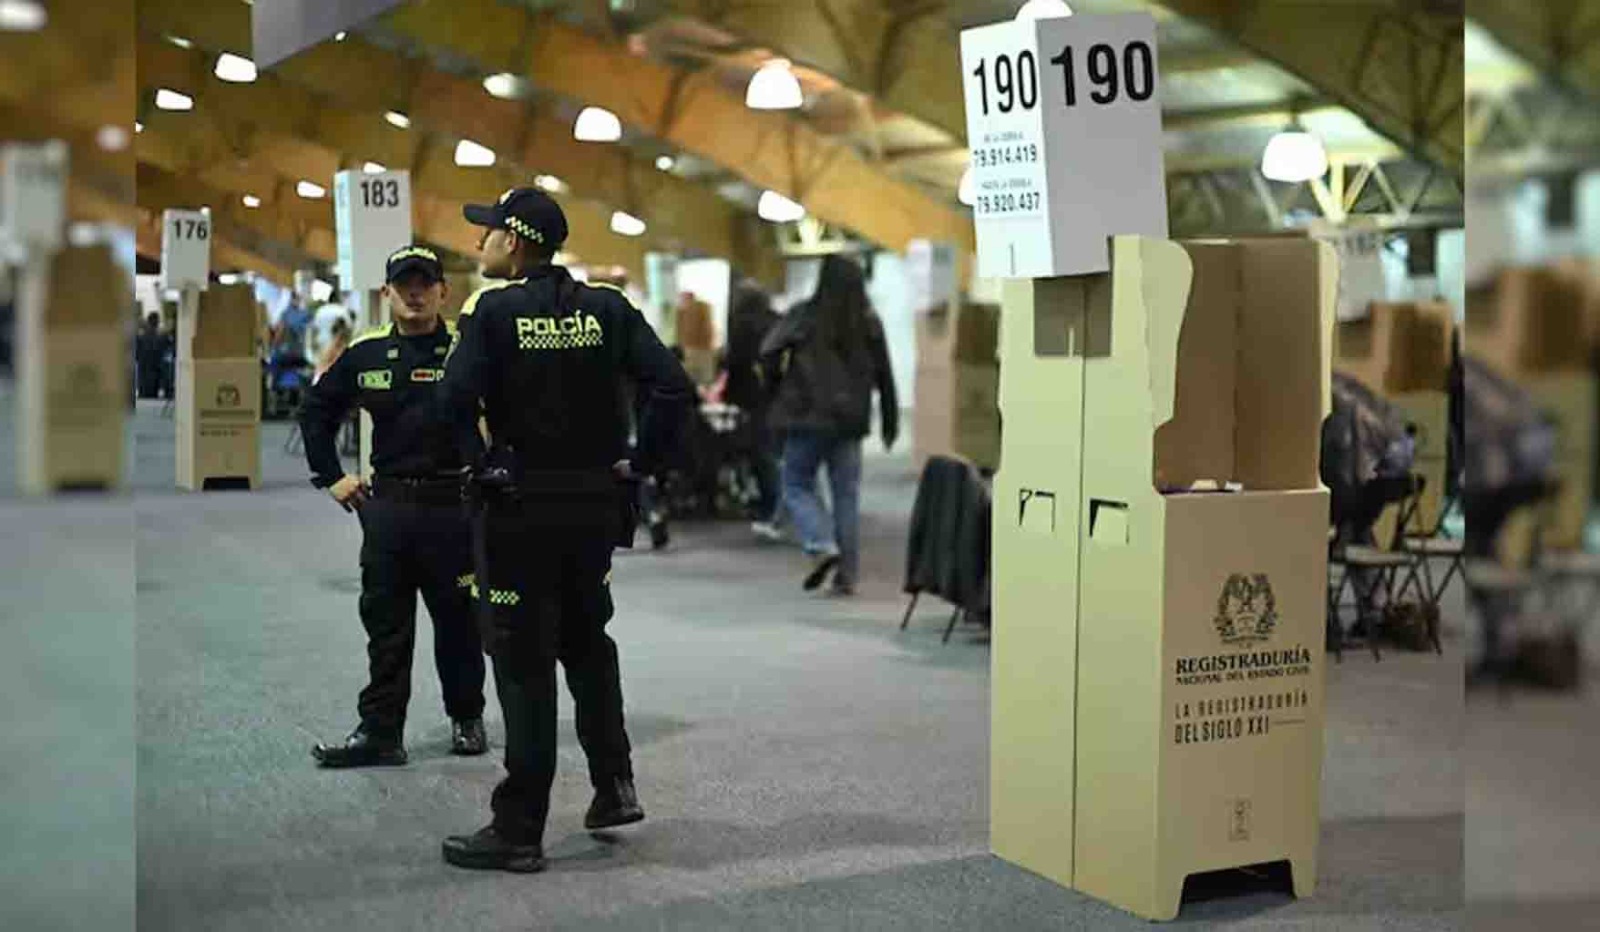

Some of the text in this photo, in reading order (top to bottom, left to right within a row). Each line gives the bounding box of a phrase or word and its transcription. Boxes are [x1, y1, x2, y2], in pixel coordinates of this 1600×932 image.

[973, 49, 1037, 116] 190
[1050, 41, 1155, 107] 190
[361, 179, 399, 208] 183
[172, 219, 208, 240] 176
[1175, 643, 1311, 675] REGISTRADURÍA
[1175, 702, 1190, 719] LA
[1175, 714, 1270, 744] DEL SIGLO XXI
